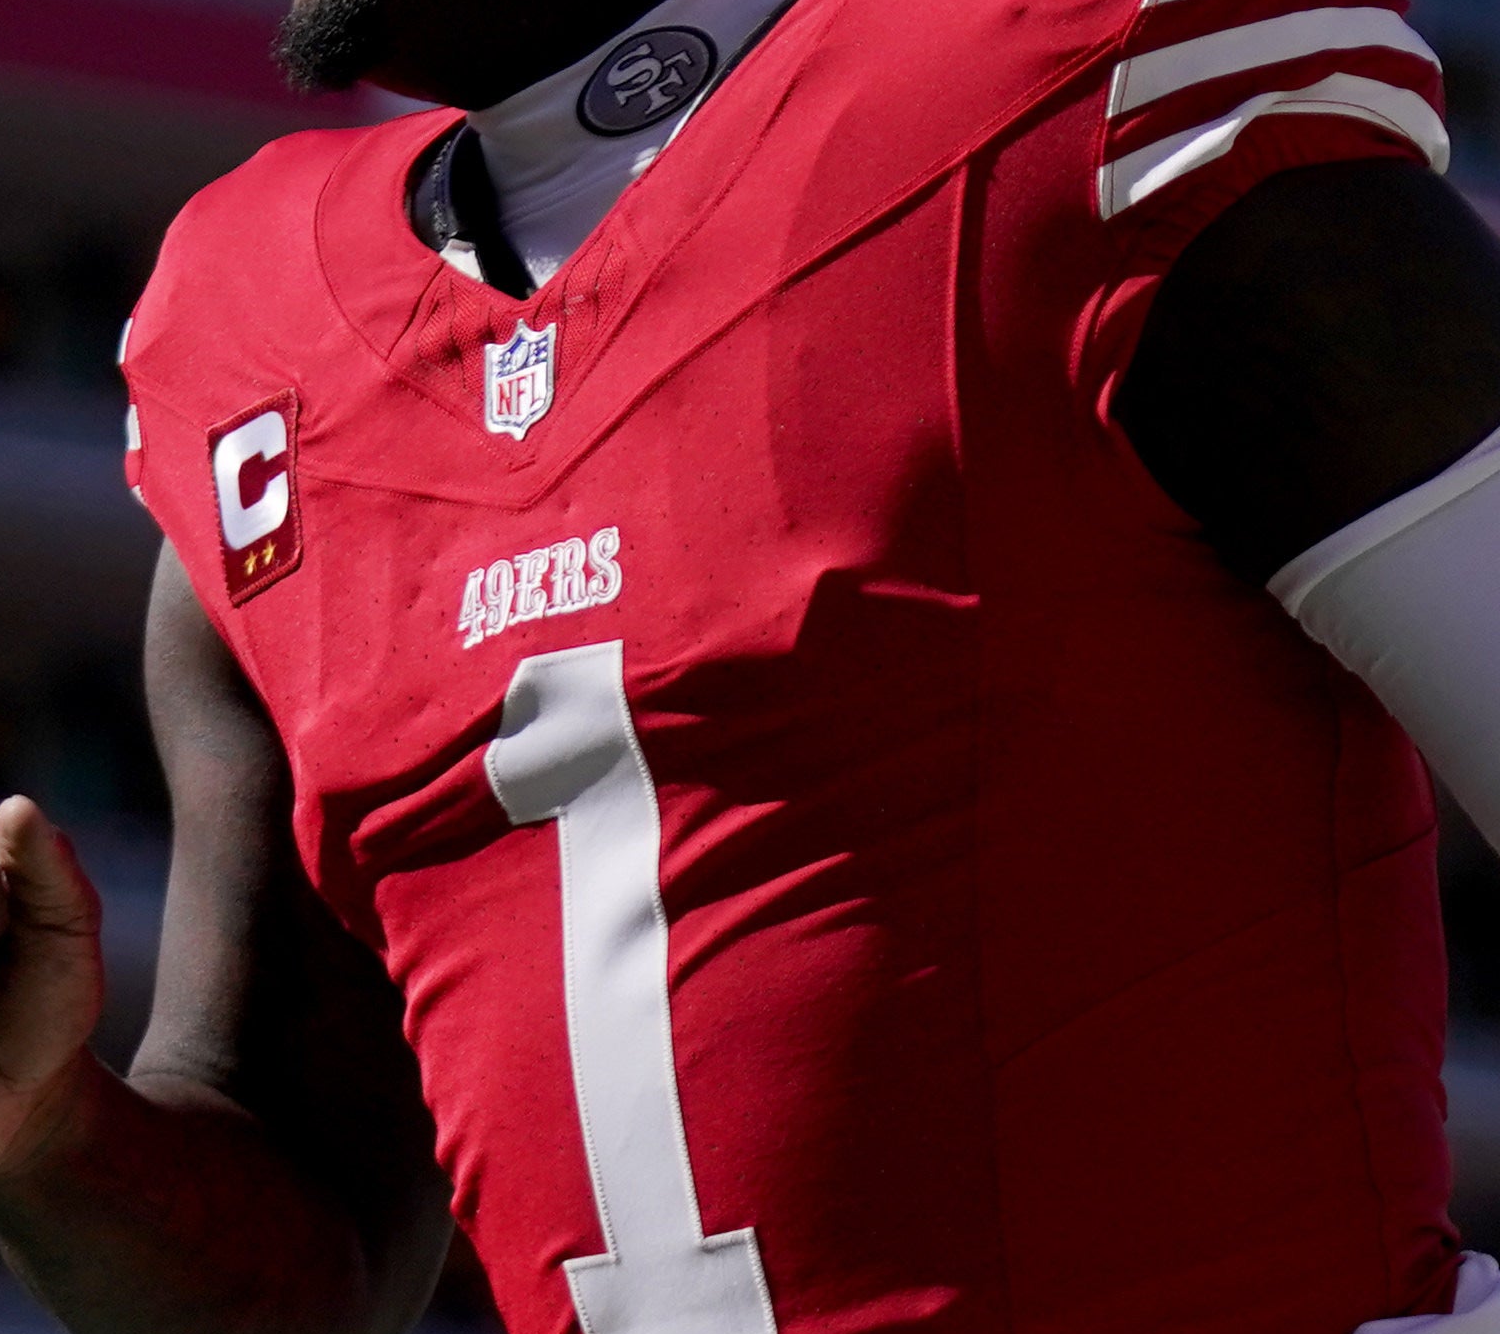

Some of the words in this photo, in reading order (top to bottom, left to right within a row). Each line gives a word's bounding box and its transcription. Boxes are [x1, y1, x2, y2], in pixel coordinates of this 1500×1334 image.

[495, 375, 544, 418] NFL
[213, 409, 290, 552] C
[457, 525, 623, 650] 49ERS
